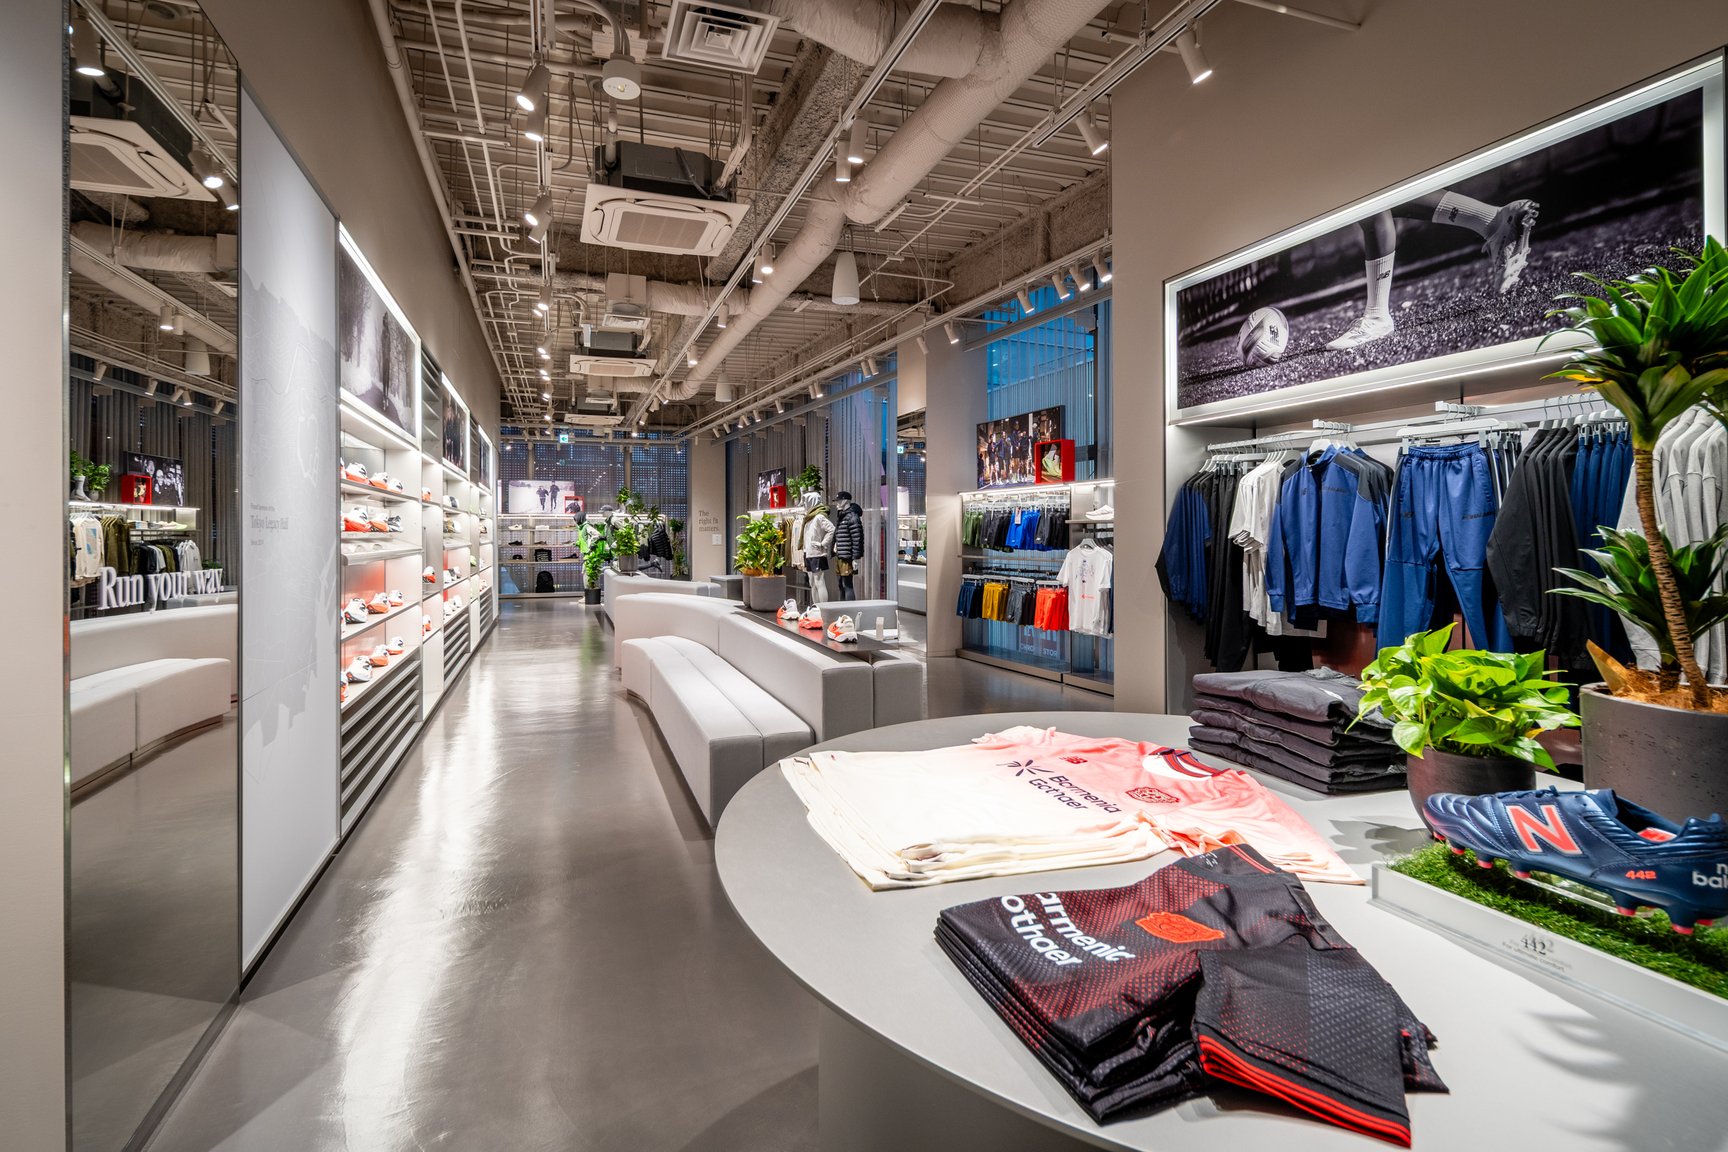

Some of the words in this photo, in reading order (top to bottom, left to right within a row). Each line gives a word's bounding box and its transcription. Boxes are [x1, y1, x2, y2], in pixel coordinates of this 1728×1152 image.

[97, 566, 146, 611] Run
[147, 570, 191, 614] your
[1505, 804, 1583, 855] N
[1625, 870, 1657, 879] 442
